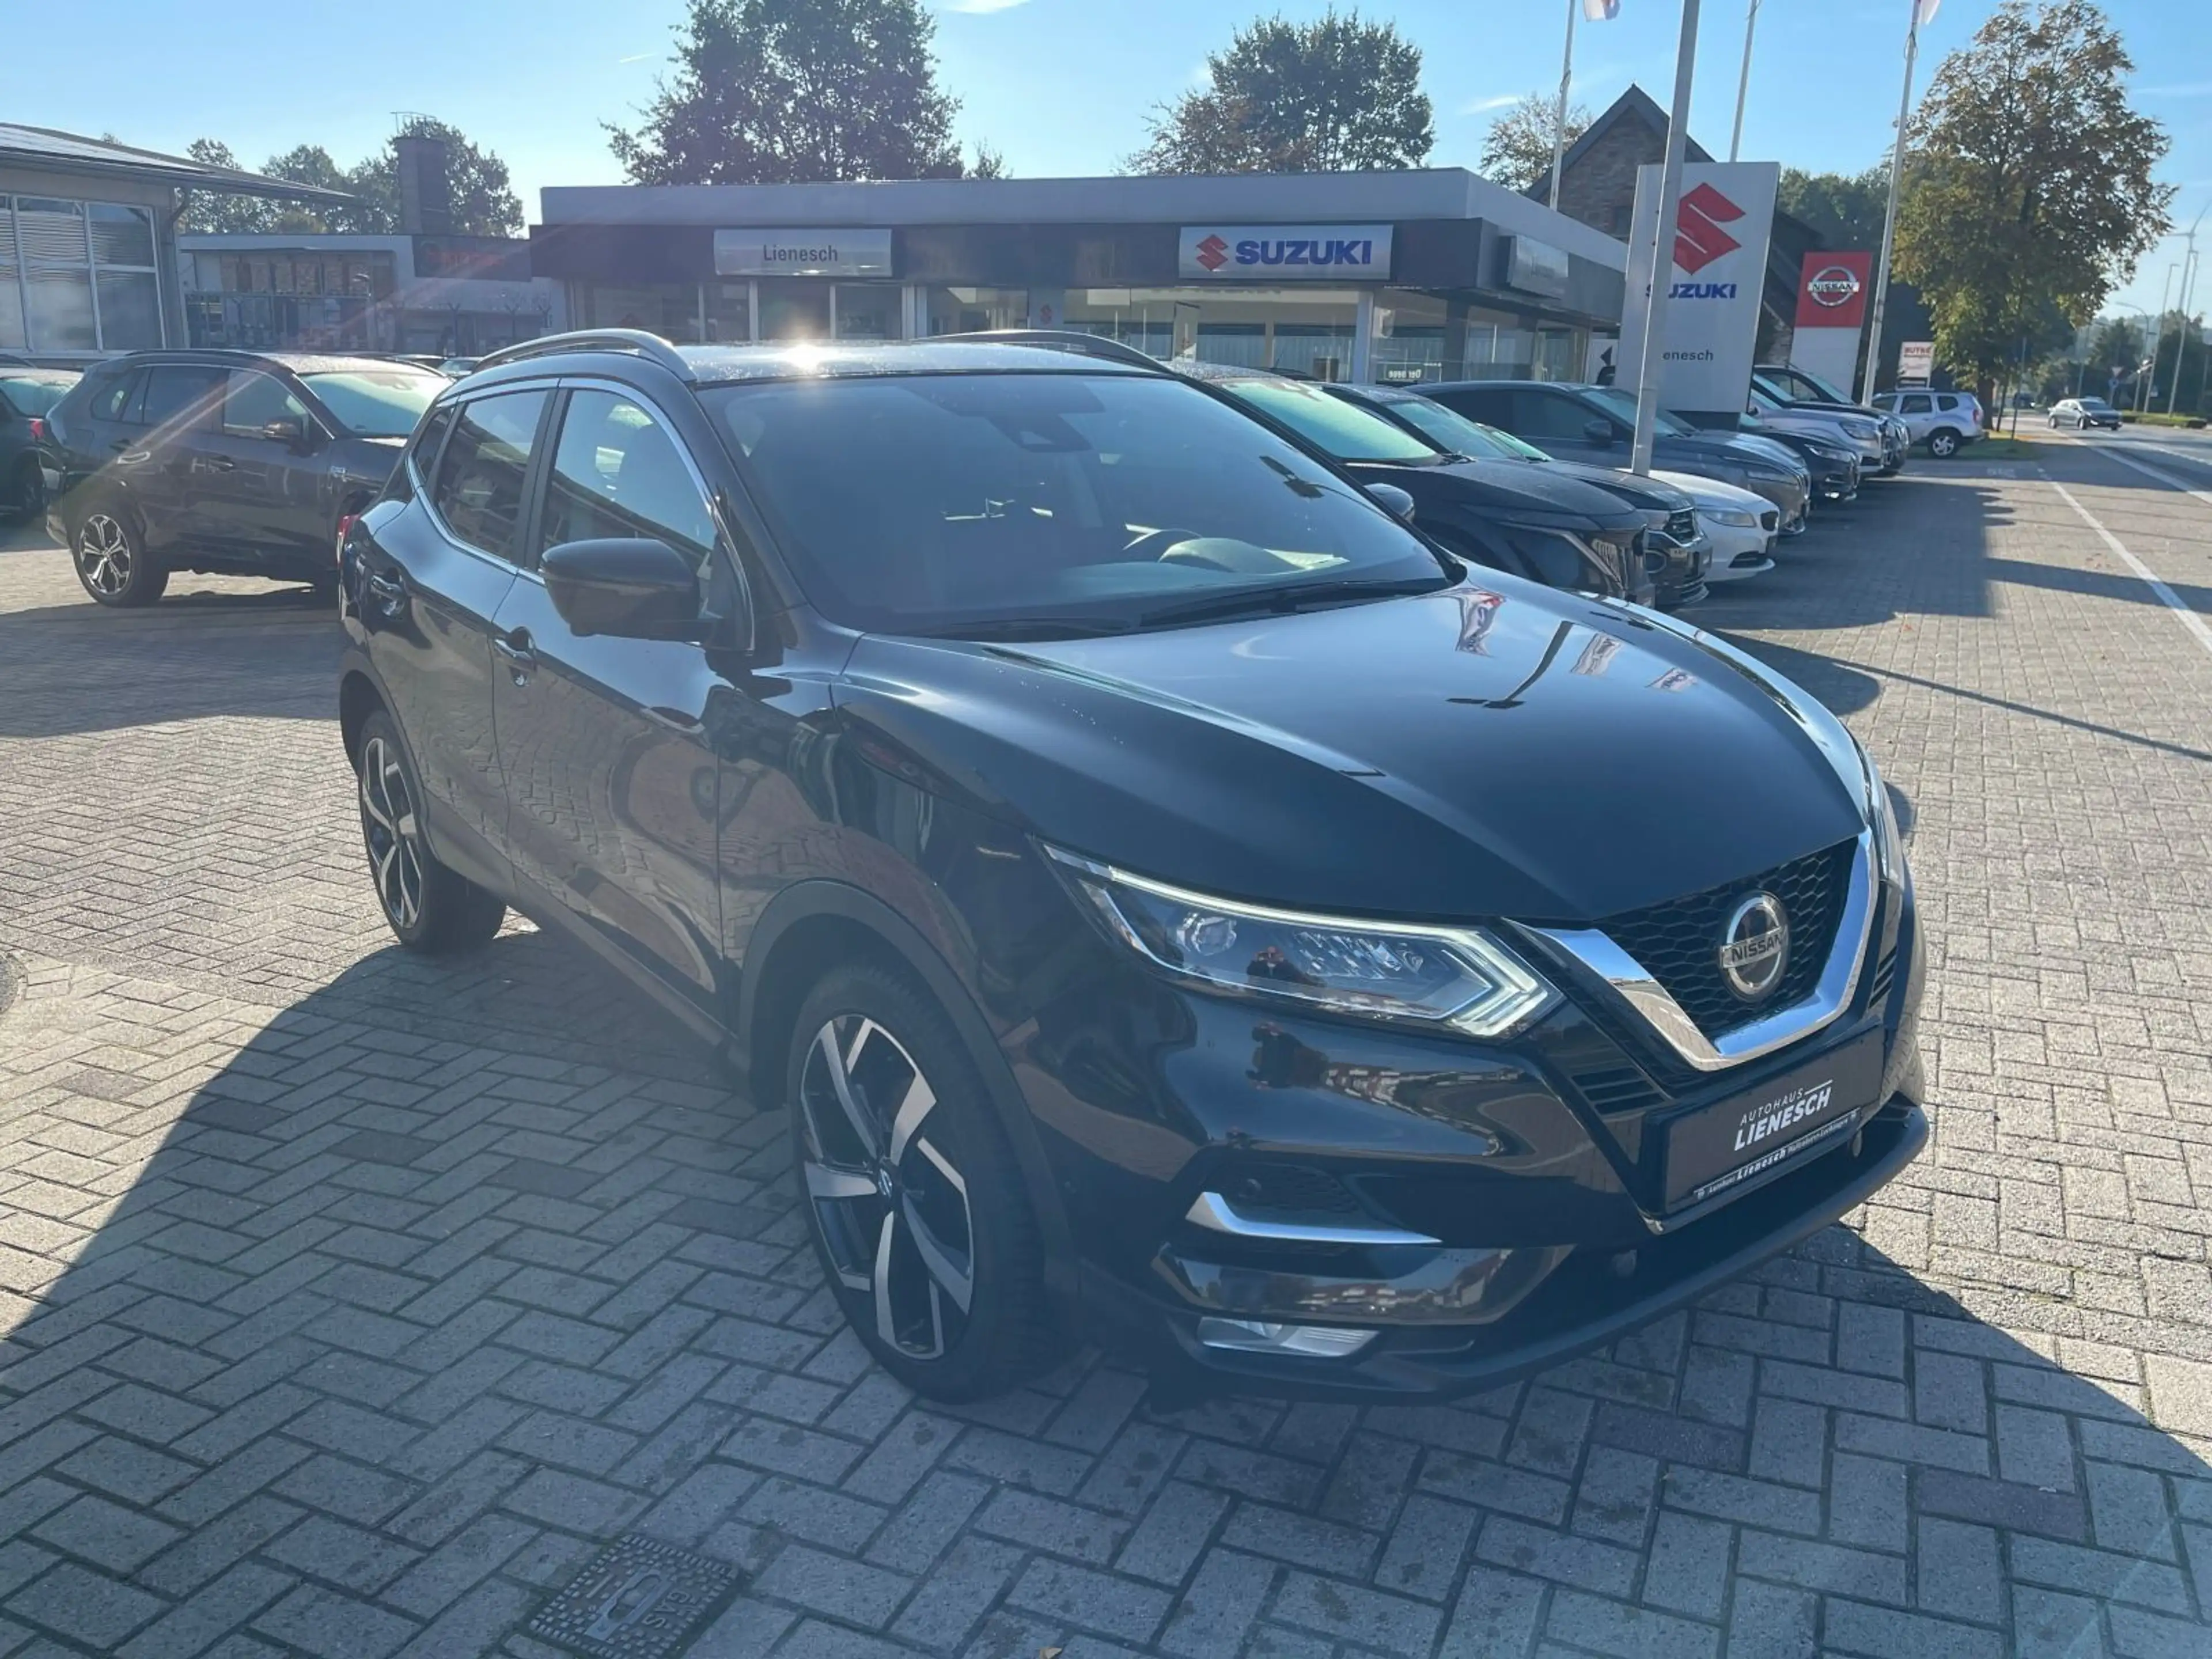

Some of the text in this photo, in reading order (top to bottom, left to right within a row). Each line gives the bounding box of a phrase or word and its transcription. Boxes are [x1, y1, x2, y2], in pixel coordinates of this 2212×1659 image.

[763, 244, 838, 262] Lienesch
[1235, 240, 1372, 265] SUZUKI
[1813, 282, 1853, 293] NISSAN
[1662, 349, 1714, 361] enesch
[1732, 934, 1783, 962] NISSAN
[1734, 1086, 1832, 1151] LIENESCH
[1740, 1088, 1804, 1126] AUTOHAUS
[1737, 1147, 1786, 1181] Lienesch
[641, 1590, 691, 1629] GAS
